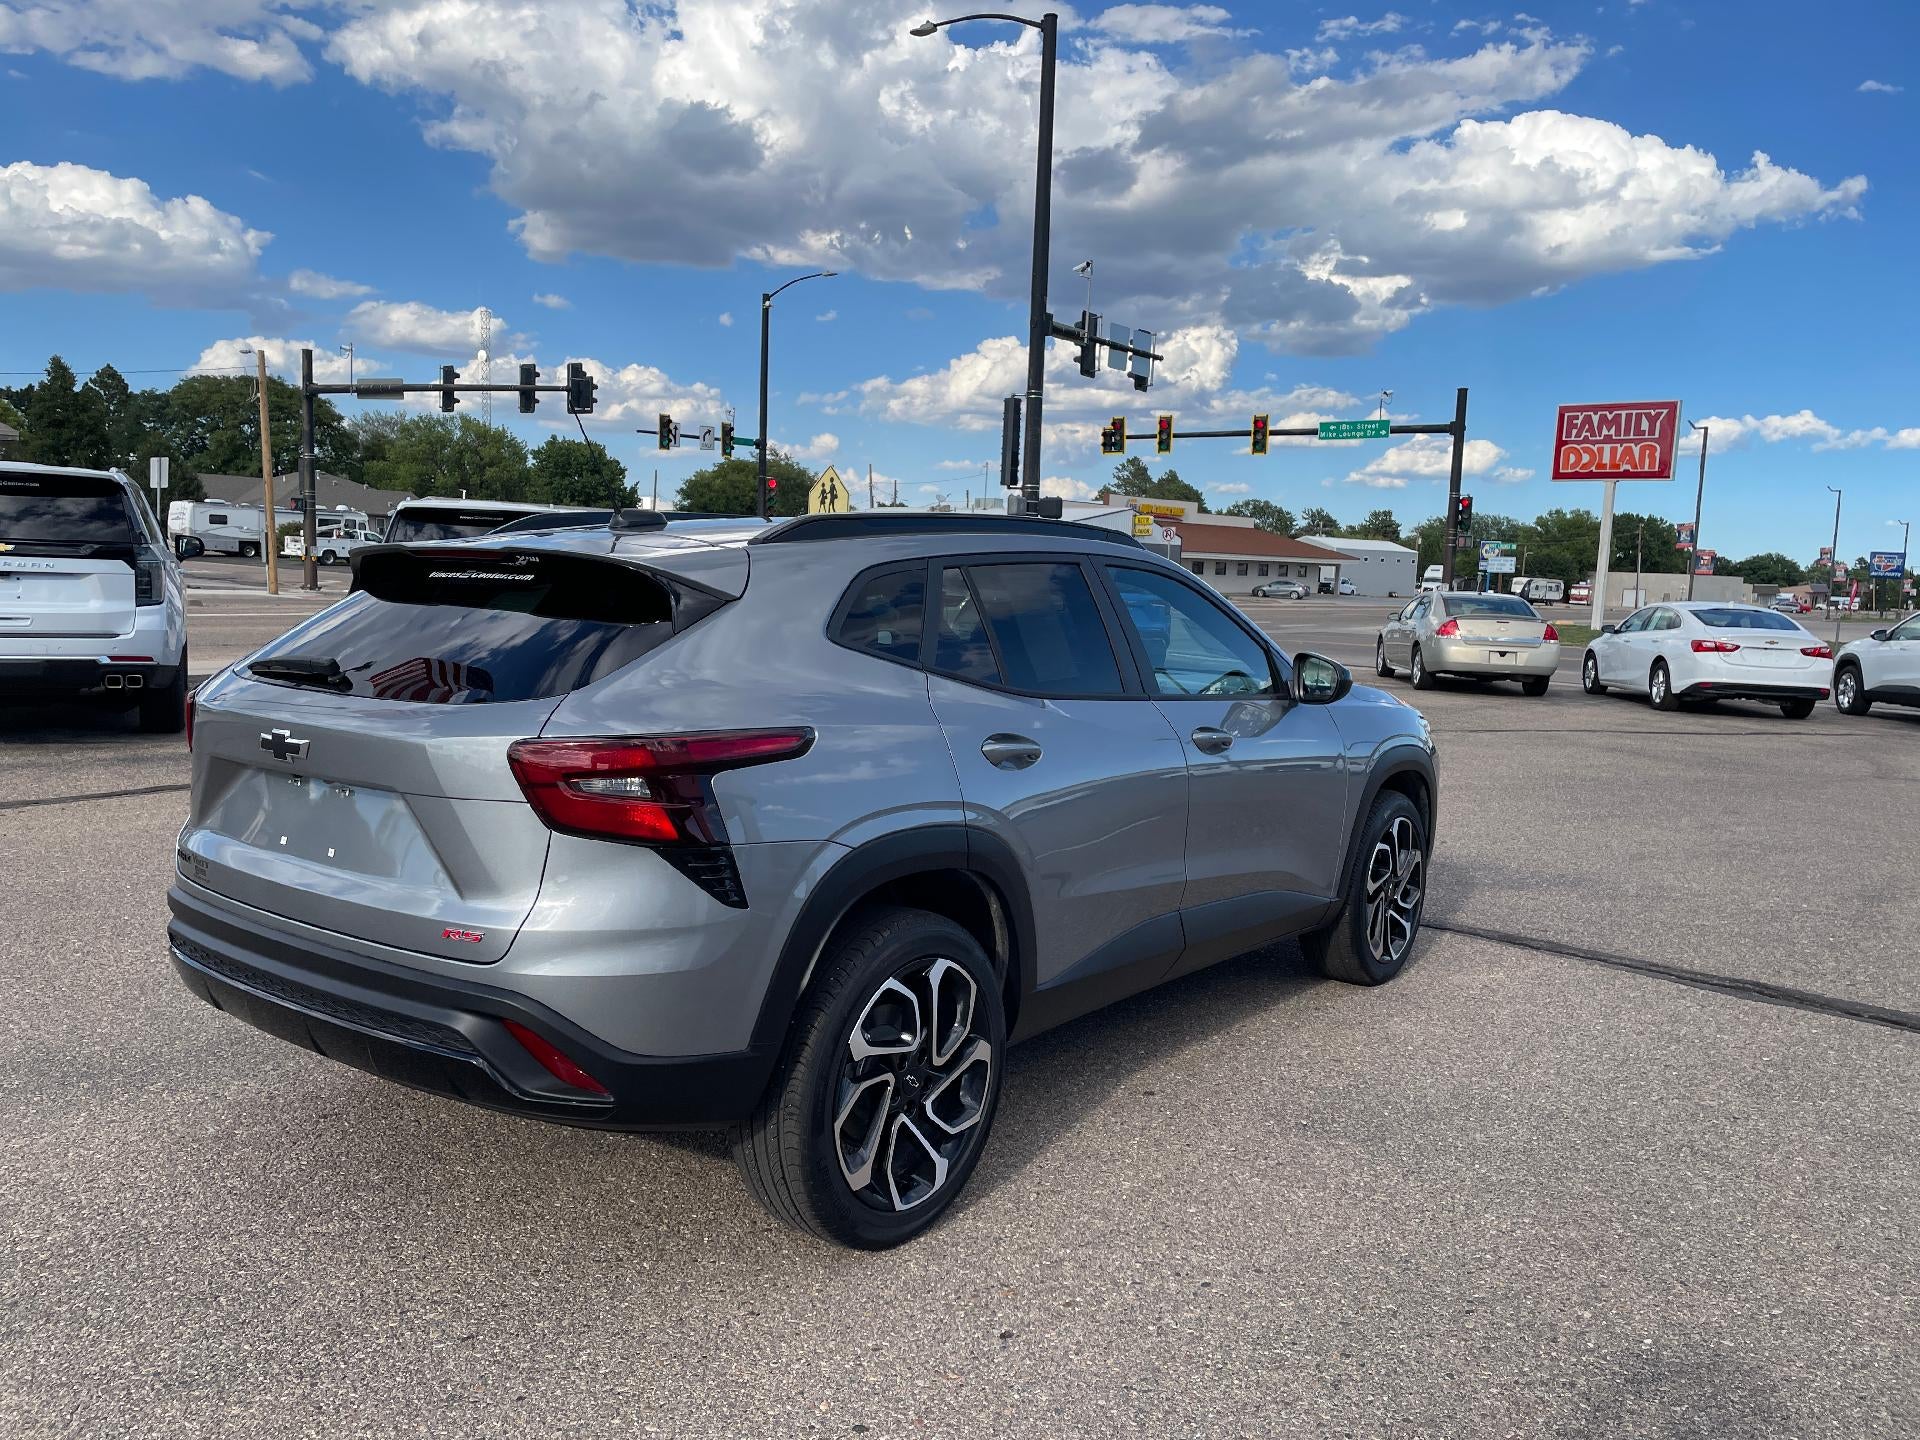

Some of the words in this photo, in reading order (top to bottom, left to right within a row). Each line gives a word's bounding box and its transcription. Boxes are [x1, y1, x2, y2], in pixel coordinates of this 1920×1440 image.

[1356, 422, 1379, 430] Street
[1563, 409, 1669, 440] FAMILY
[1560, 441, 1661, 473] DOLLAR
[441, 928, 485, 943] RS
